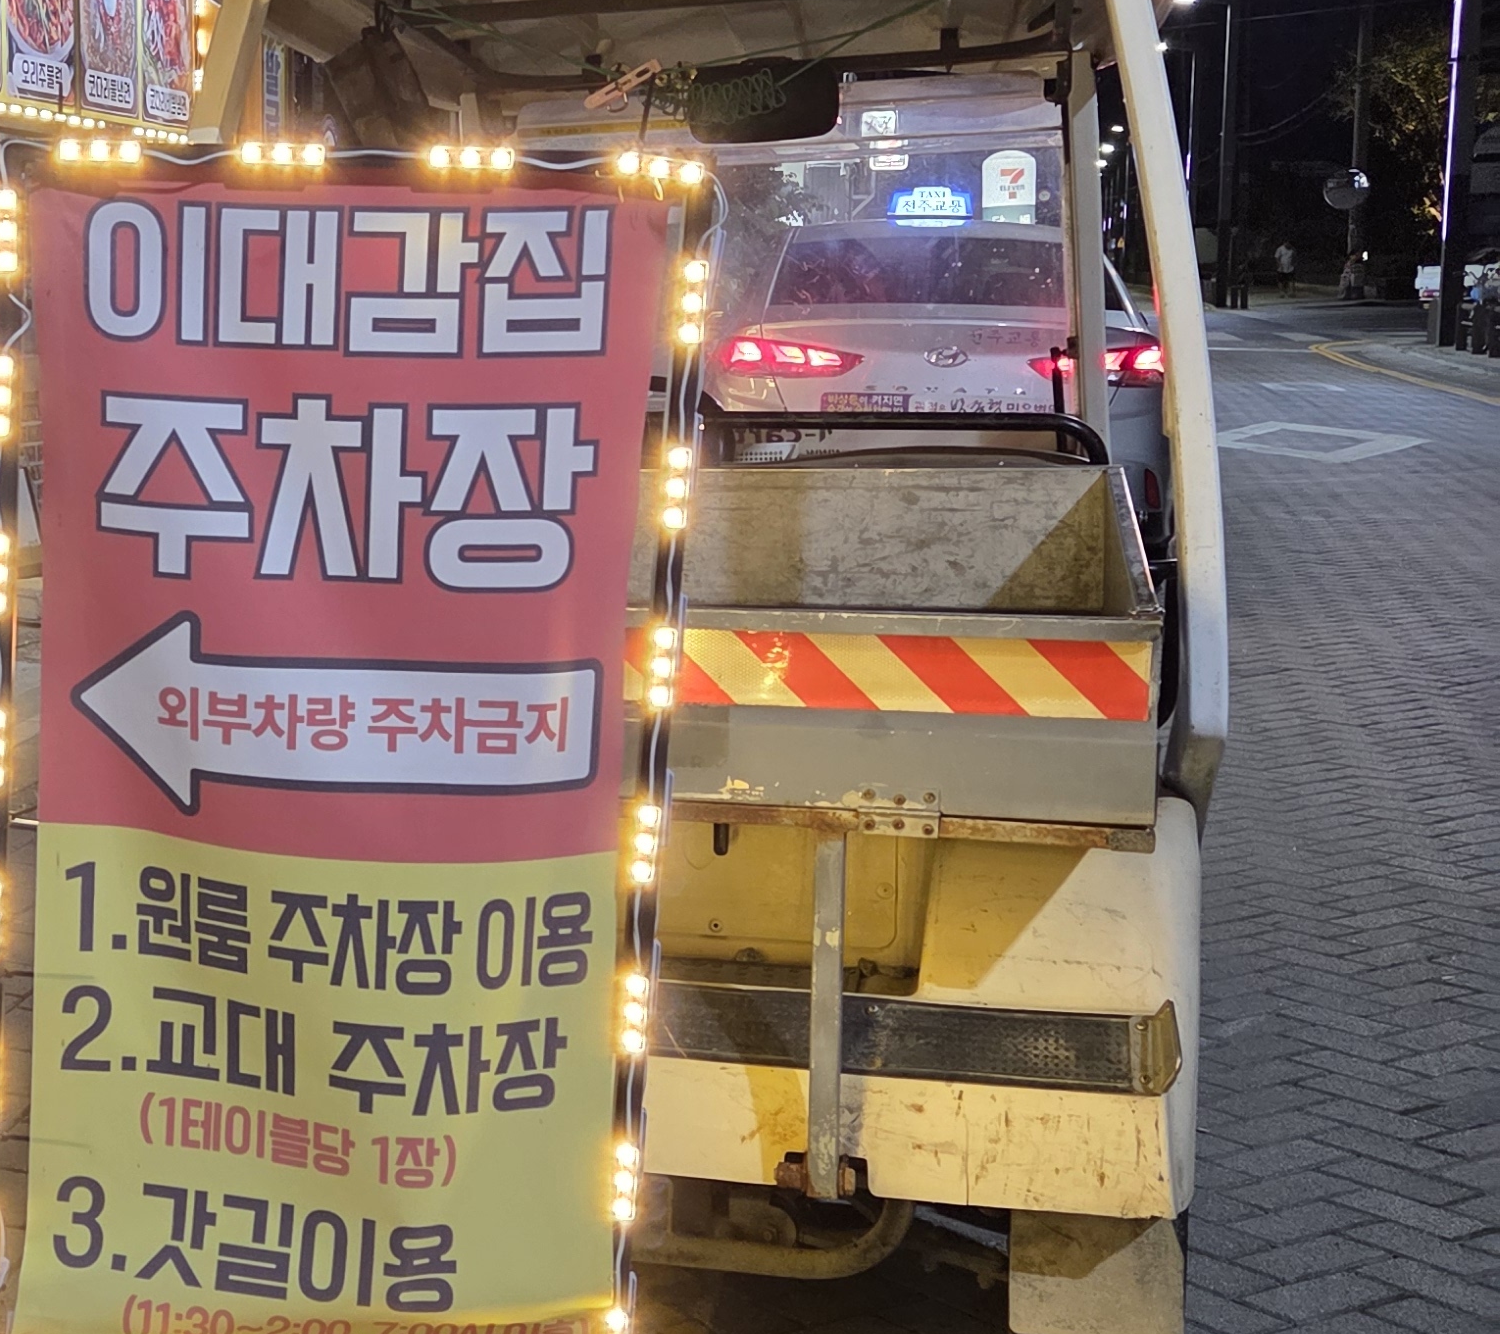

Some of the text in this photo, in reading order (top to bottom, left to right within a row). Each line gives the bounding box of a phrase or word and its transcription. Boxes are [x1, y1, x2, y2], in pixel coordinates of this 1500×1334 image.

[920, 190, 946, 199] TAXI
[84, 199, 615, 357] 이대감집
[95, 390, 600, 594] 주차장
[157, 685, 571, 755] 외부차량 주차금지
[268, 889, 463, 996] 주차장
[476, 891, 593, 990] 이용
[328, 1017, 568, 1117] 주차장
[139, 1091, 458, 1190] (1테이블당 1장)
